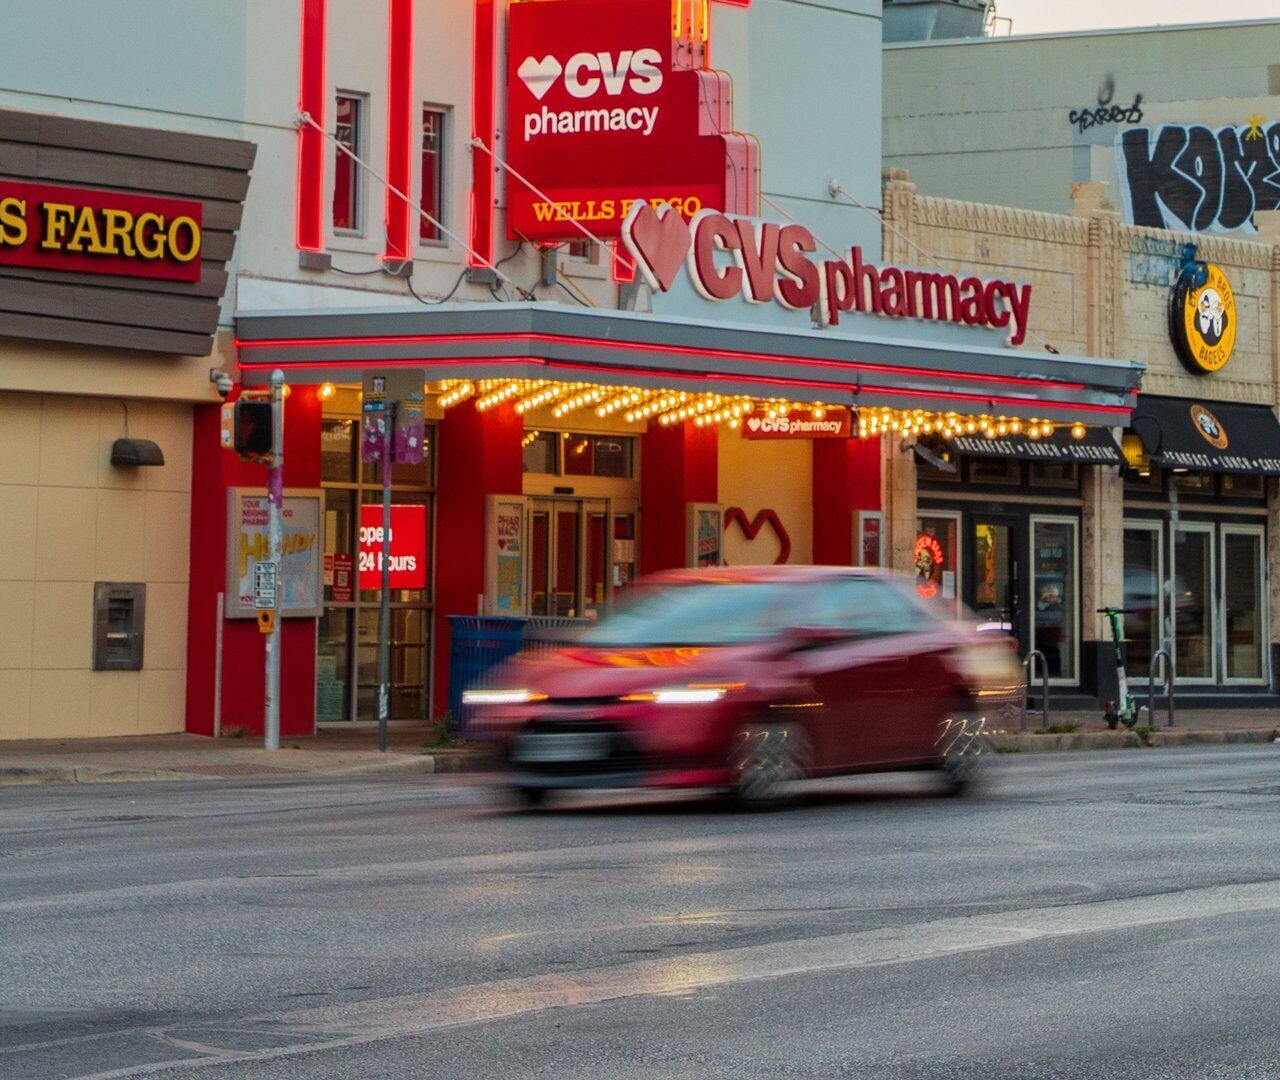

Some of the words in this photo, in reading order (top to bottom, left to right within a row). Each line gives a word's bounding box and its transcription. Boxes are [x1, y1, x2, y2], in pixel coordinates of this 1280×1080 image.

[564, 48, 663, 99] CVS
[524, 105, 659, 142] pharmacy
[532, 200, 615, 221] WELLS
[41, 201, 201, 262] FARGO
[692, 217, 820, 309] CVS
[824, 245, 1032, 346] pharmacy
[1216, 276, 1233, 310] BROS
[1198, 346, 1226, 366] BAGELS
[761, 417, 789, 432] CVS
[790, 420, 842, 434] pharmacy
[954, 436, 1016, 454] BREAKFAST
[1024, 441, 1062, 457] LUNCH
[1069, 444, 1119, 460] CATERING
[1220, 456, 1252, 469] LUNCH
[358, 551, 376, 572] 24
